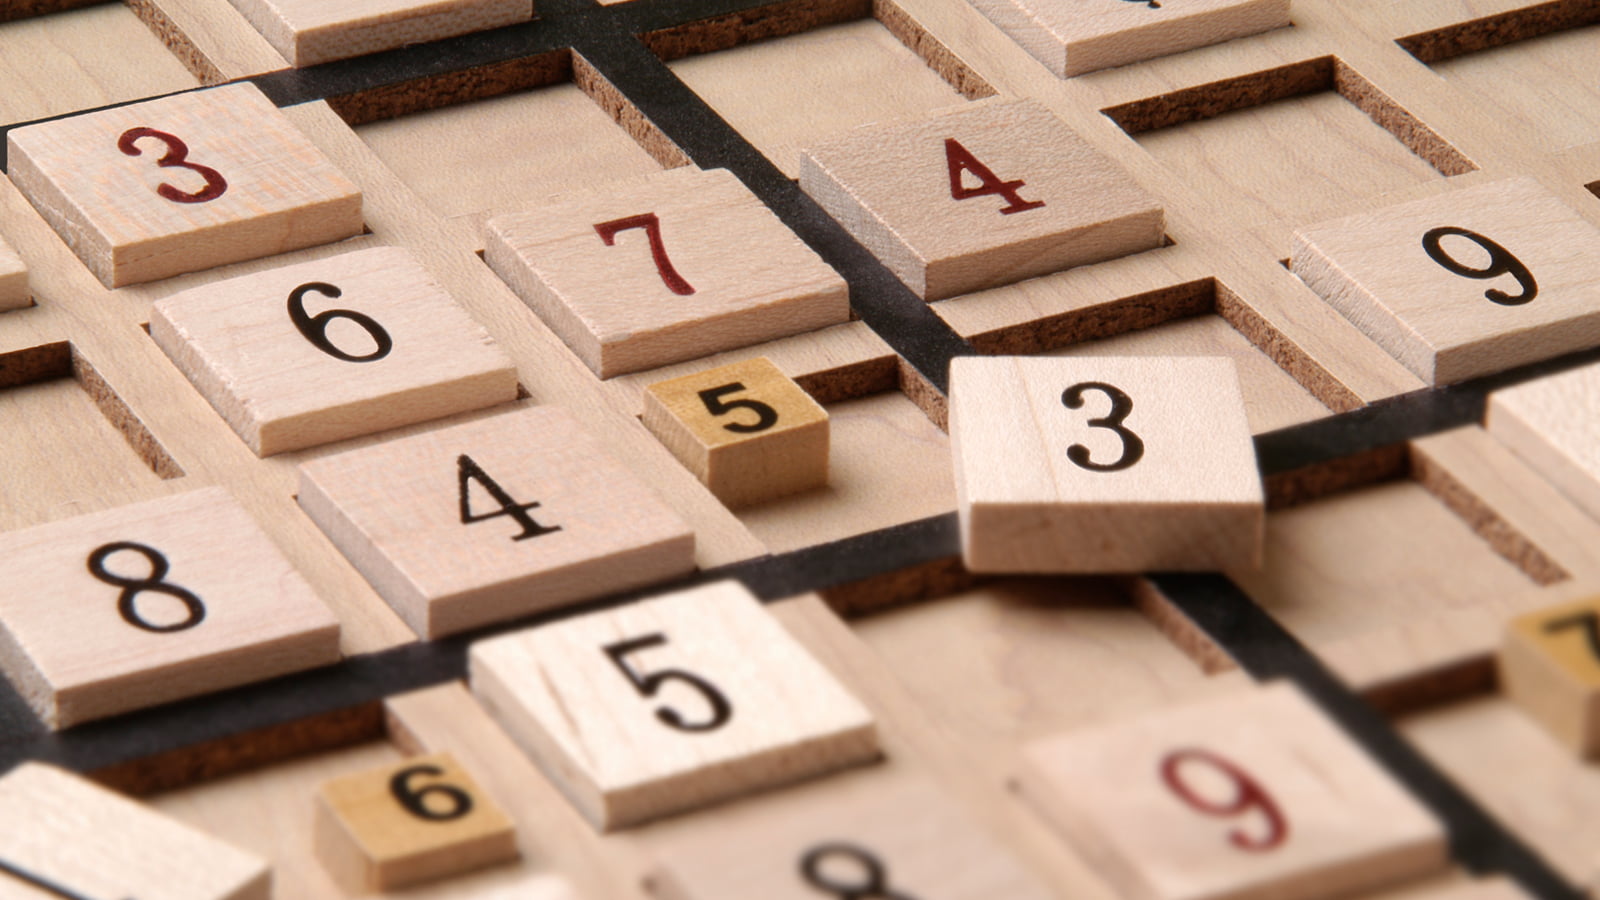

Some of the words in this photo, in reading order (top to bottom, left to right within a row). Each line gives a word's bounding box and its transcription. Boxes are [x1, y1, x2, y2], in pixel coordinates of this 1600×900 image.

[118, 127, 227, 203] 3
[945, 138, 1045, 215] 4
[594, 213, 695, 295] 7
[1421, 226, 1539, 307] 9
[286, 281, 393, 363] 6
[697, 381, 779, 434] 5
[1062, 382, 1145, 473] 3
[457, 454, 562, 542] 4
[86, 541, 206, 634] 8
[601, 632, 733, 734] 5
[389, 765, 473, 822] 6
[1159, 748, 1290, 852] 9
